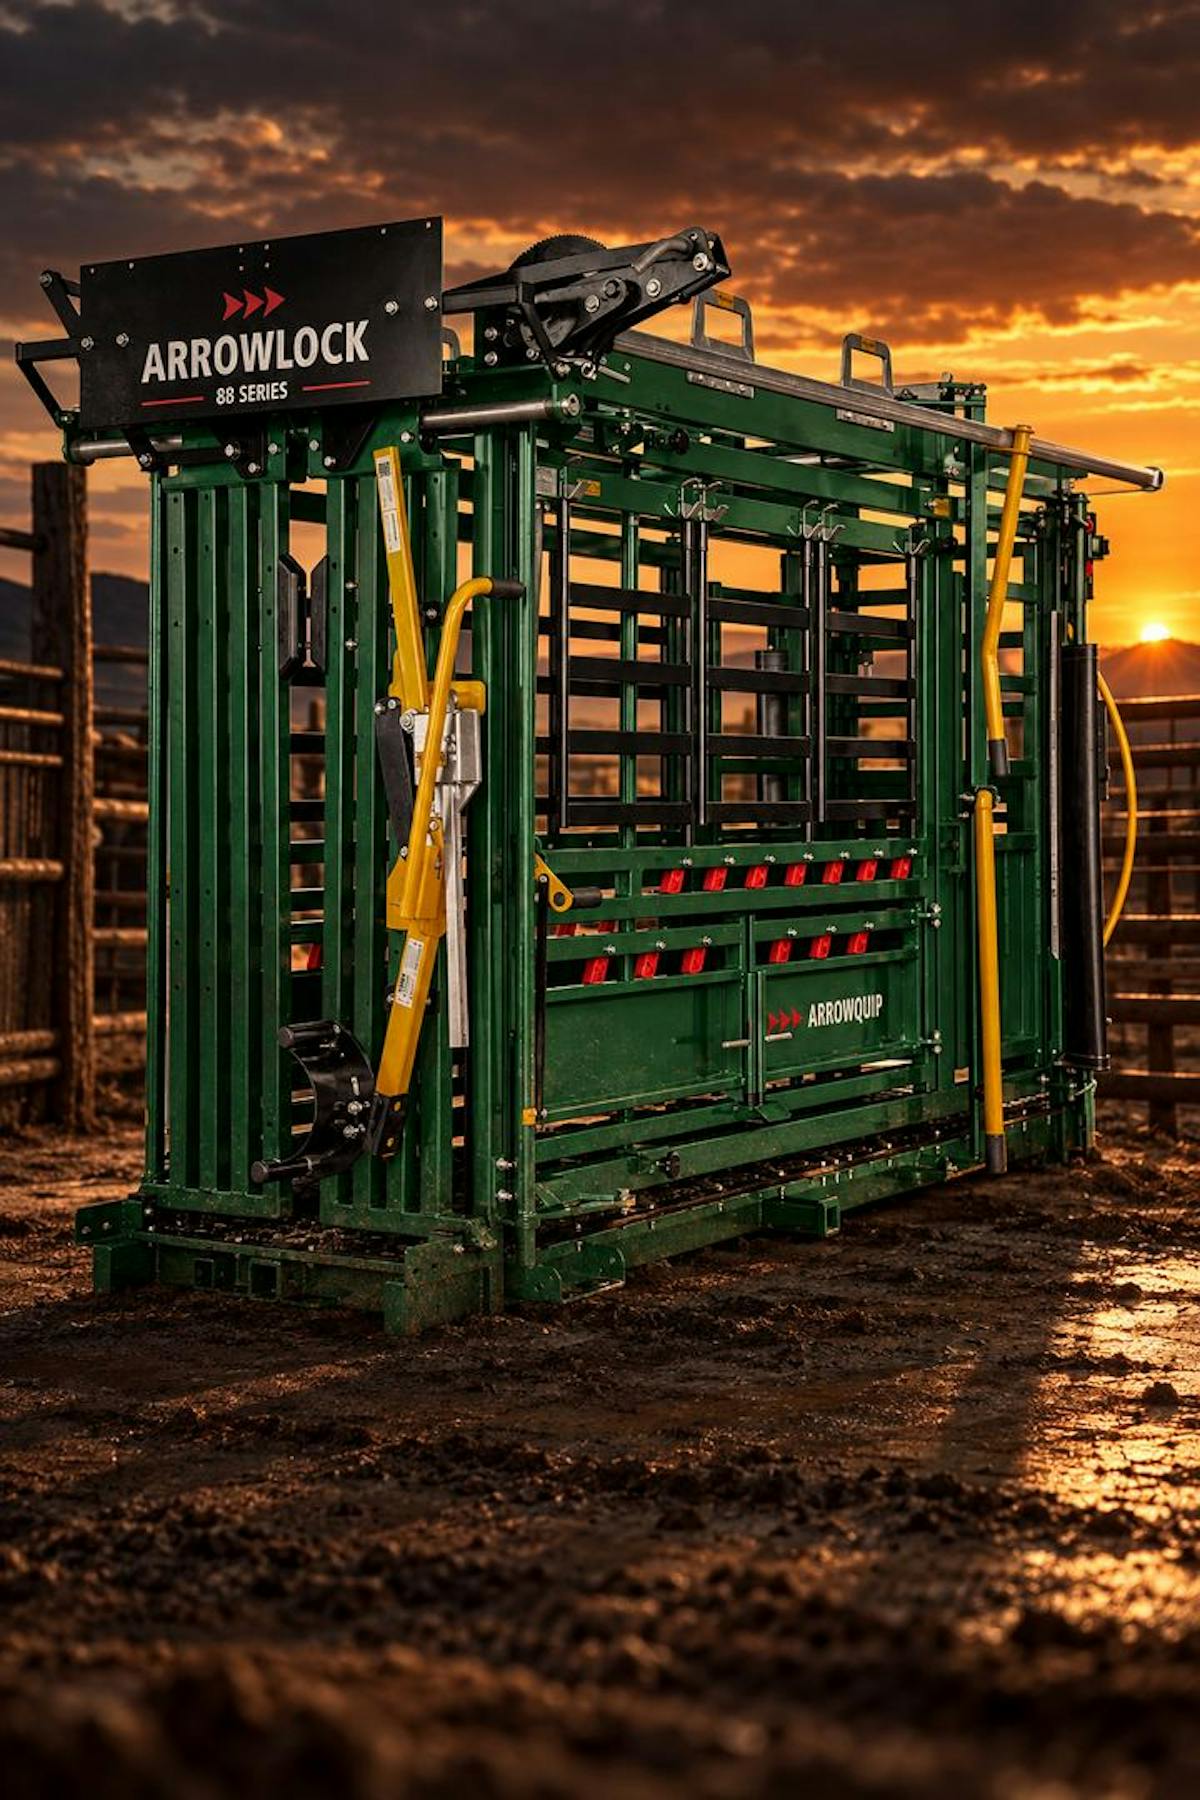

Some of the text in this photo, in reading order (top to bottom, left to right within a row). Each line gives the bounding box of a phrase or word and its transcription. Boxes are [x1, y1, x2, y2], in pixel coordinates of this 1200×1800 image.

[141, 319, 370, 384] ARROWLOCK
[215, 381, 288, 405] 88 SERIES
[807, 994, 882, 1028] ARROWQUIP
